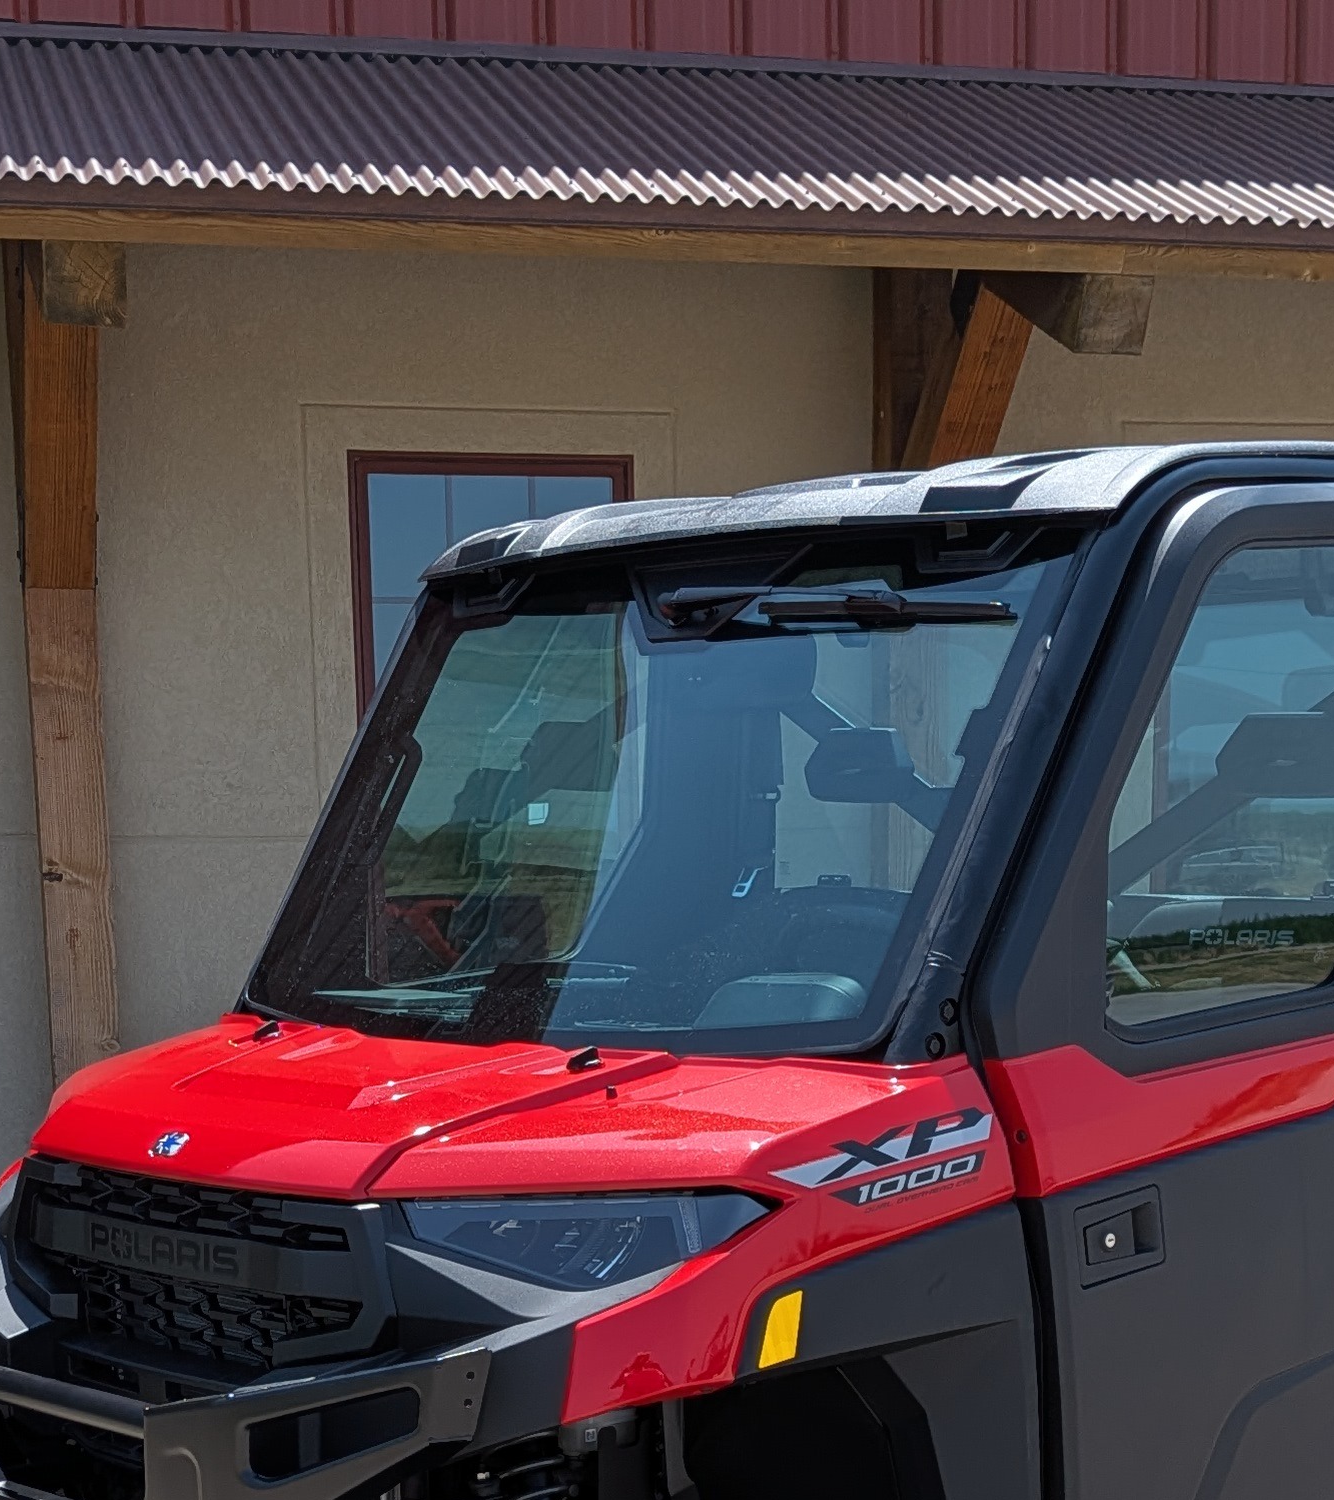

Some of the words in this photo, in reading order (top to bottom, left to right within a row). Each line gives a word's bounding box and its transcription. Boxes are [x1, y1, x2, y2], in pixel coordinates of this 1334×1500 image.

[1189, 928, 1294, 945] POLARIS
[814, 1106, 985, 1185] XP
[858, 1154, 977, 1204] 1000
[896, 1182, 954, 1204] OVERHEAD
[91, 1222, 240, 1278] POLARIS
